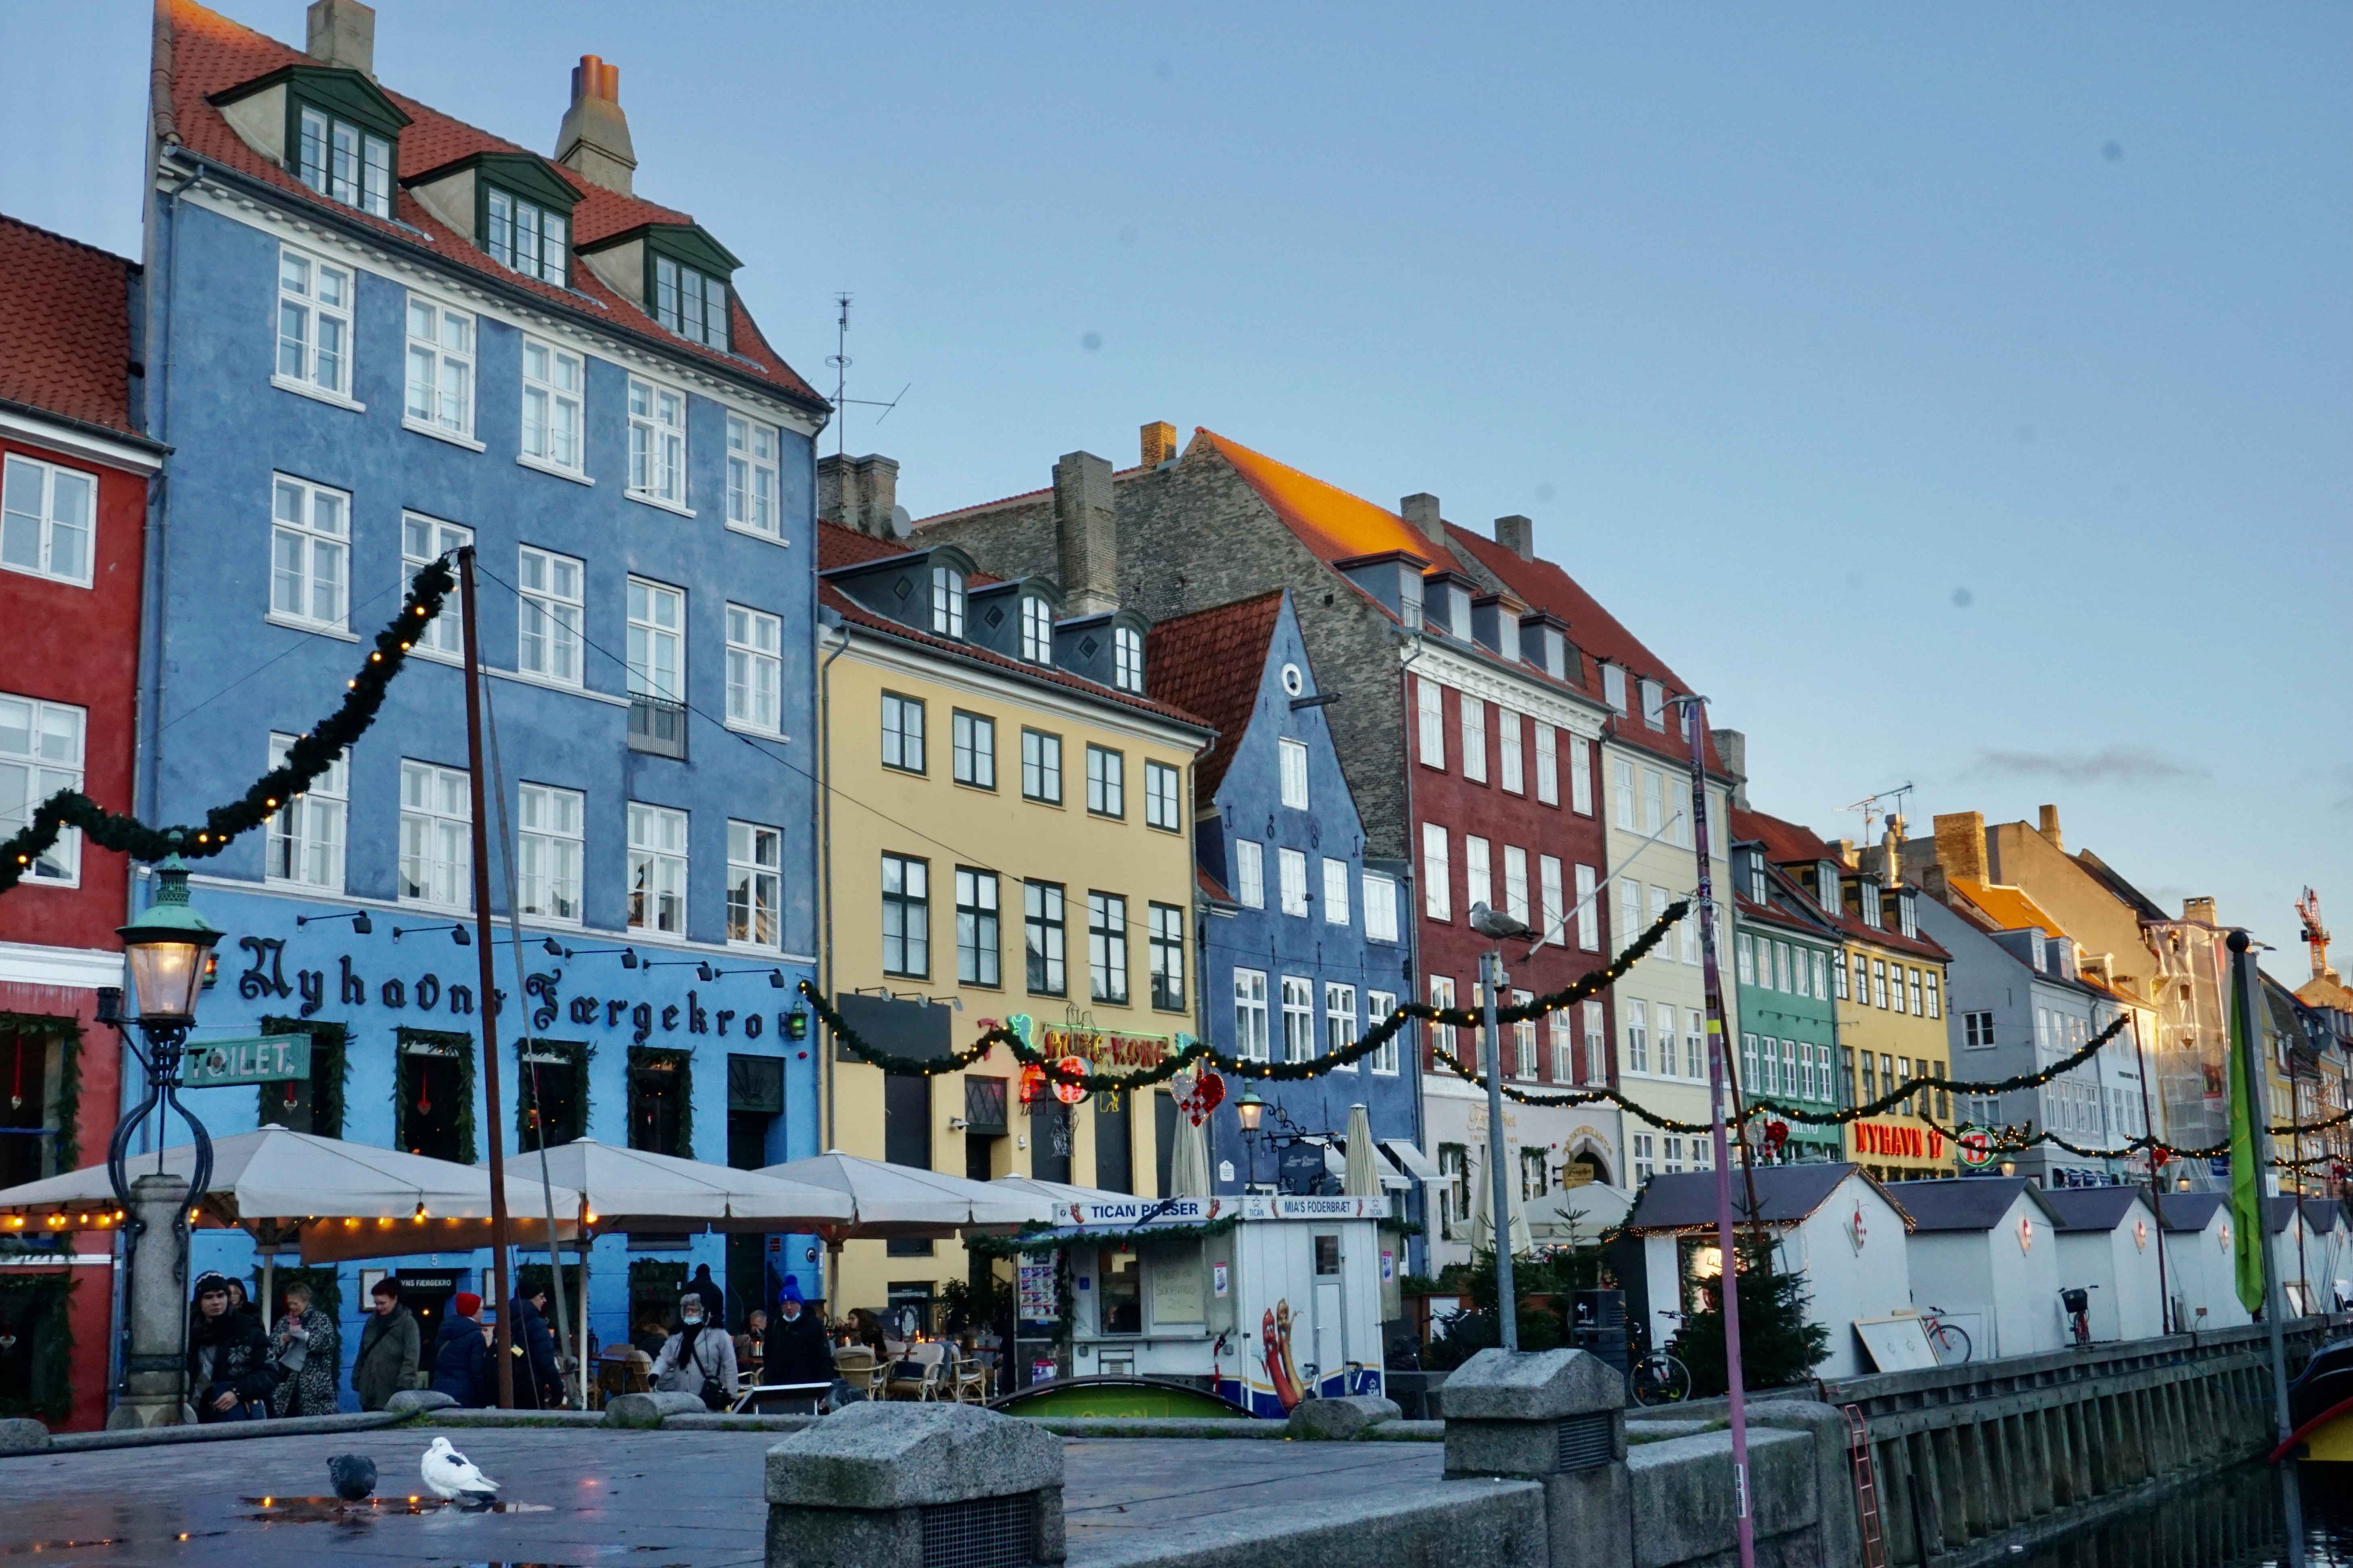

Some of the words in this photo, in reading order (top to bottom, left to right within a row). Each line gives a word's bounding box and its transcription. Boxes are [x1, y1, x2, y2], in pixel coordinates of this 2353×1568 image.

[526, 968, 763, 1044] Færgekro
[188, 1042, 290, 1079] TOILET
[1855, 1122, 1924, 1157] NYHAVN
[1927, 1130, 1944, 1158] 17
[1963, 1135, 1986, 1161] 17
[1092, 1204, 1136, 1218] TICAN
[1284, 1201, 1305, 1213] MIA'S
[1308, 1201, 1351, 1213] FODERBRÆT
[431, 1254, 438, 1266] 5
[416, 1279, 451, 1287] FÆRGEKRO
